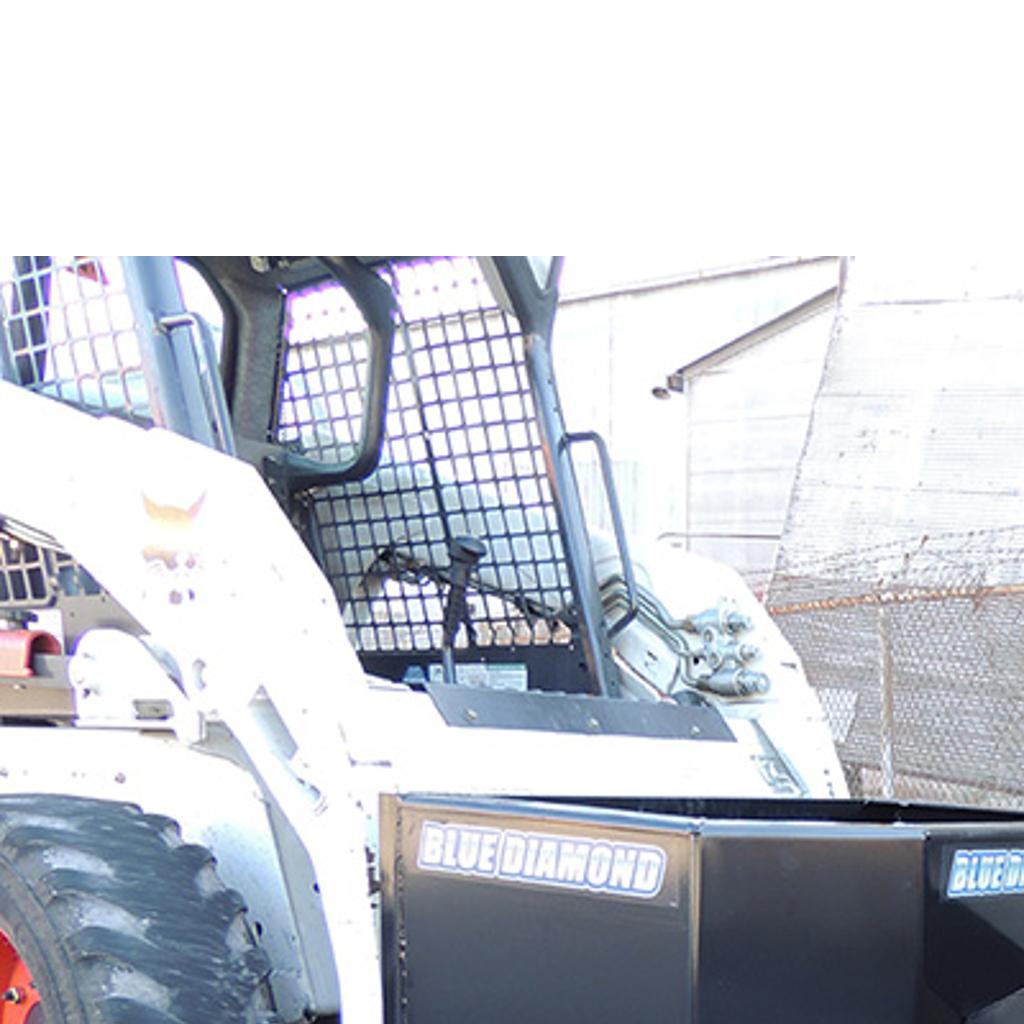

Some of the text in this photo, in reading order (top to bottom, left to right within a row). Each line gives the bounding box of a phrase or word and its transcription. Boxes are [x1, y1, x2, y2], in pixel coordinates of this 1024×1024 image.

[421, 825, 663, 892] BLUE DIAMOND
[951, 855, 1005, 892] BLUE
